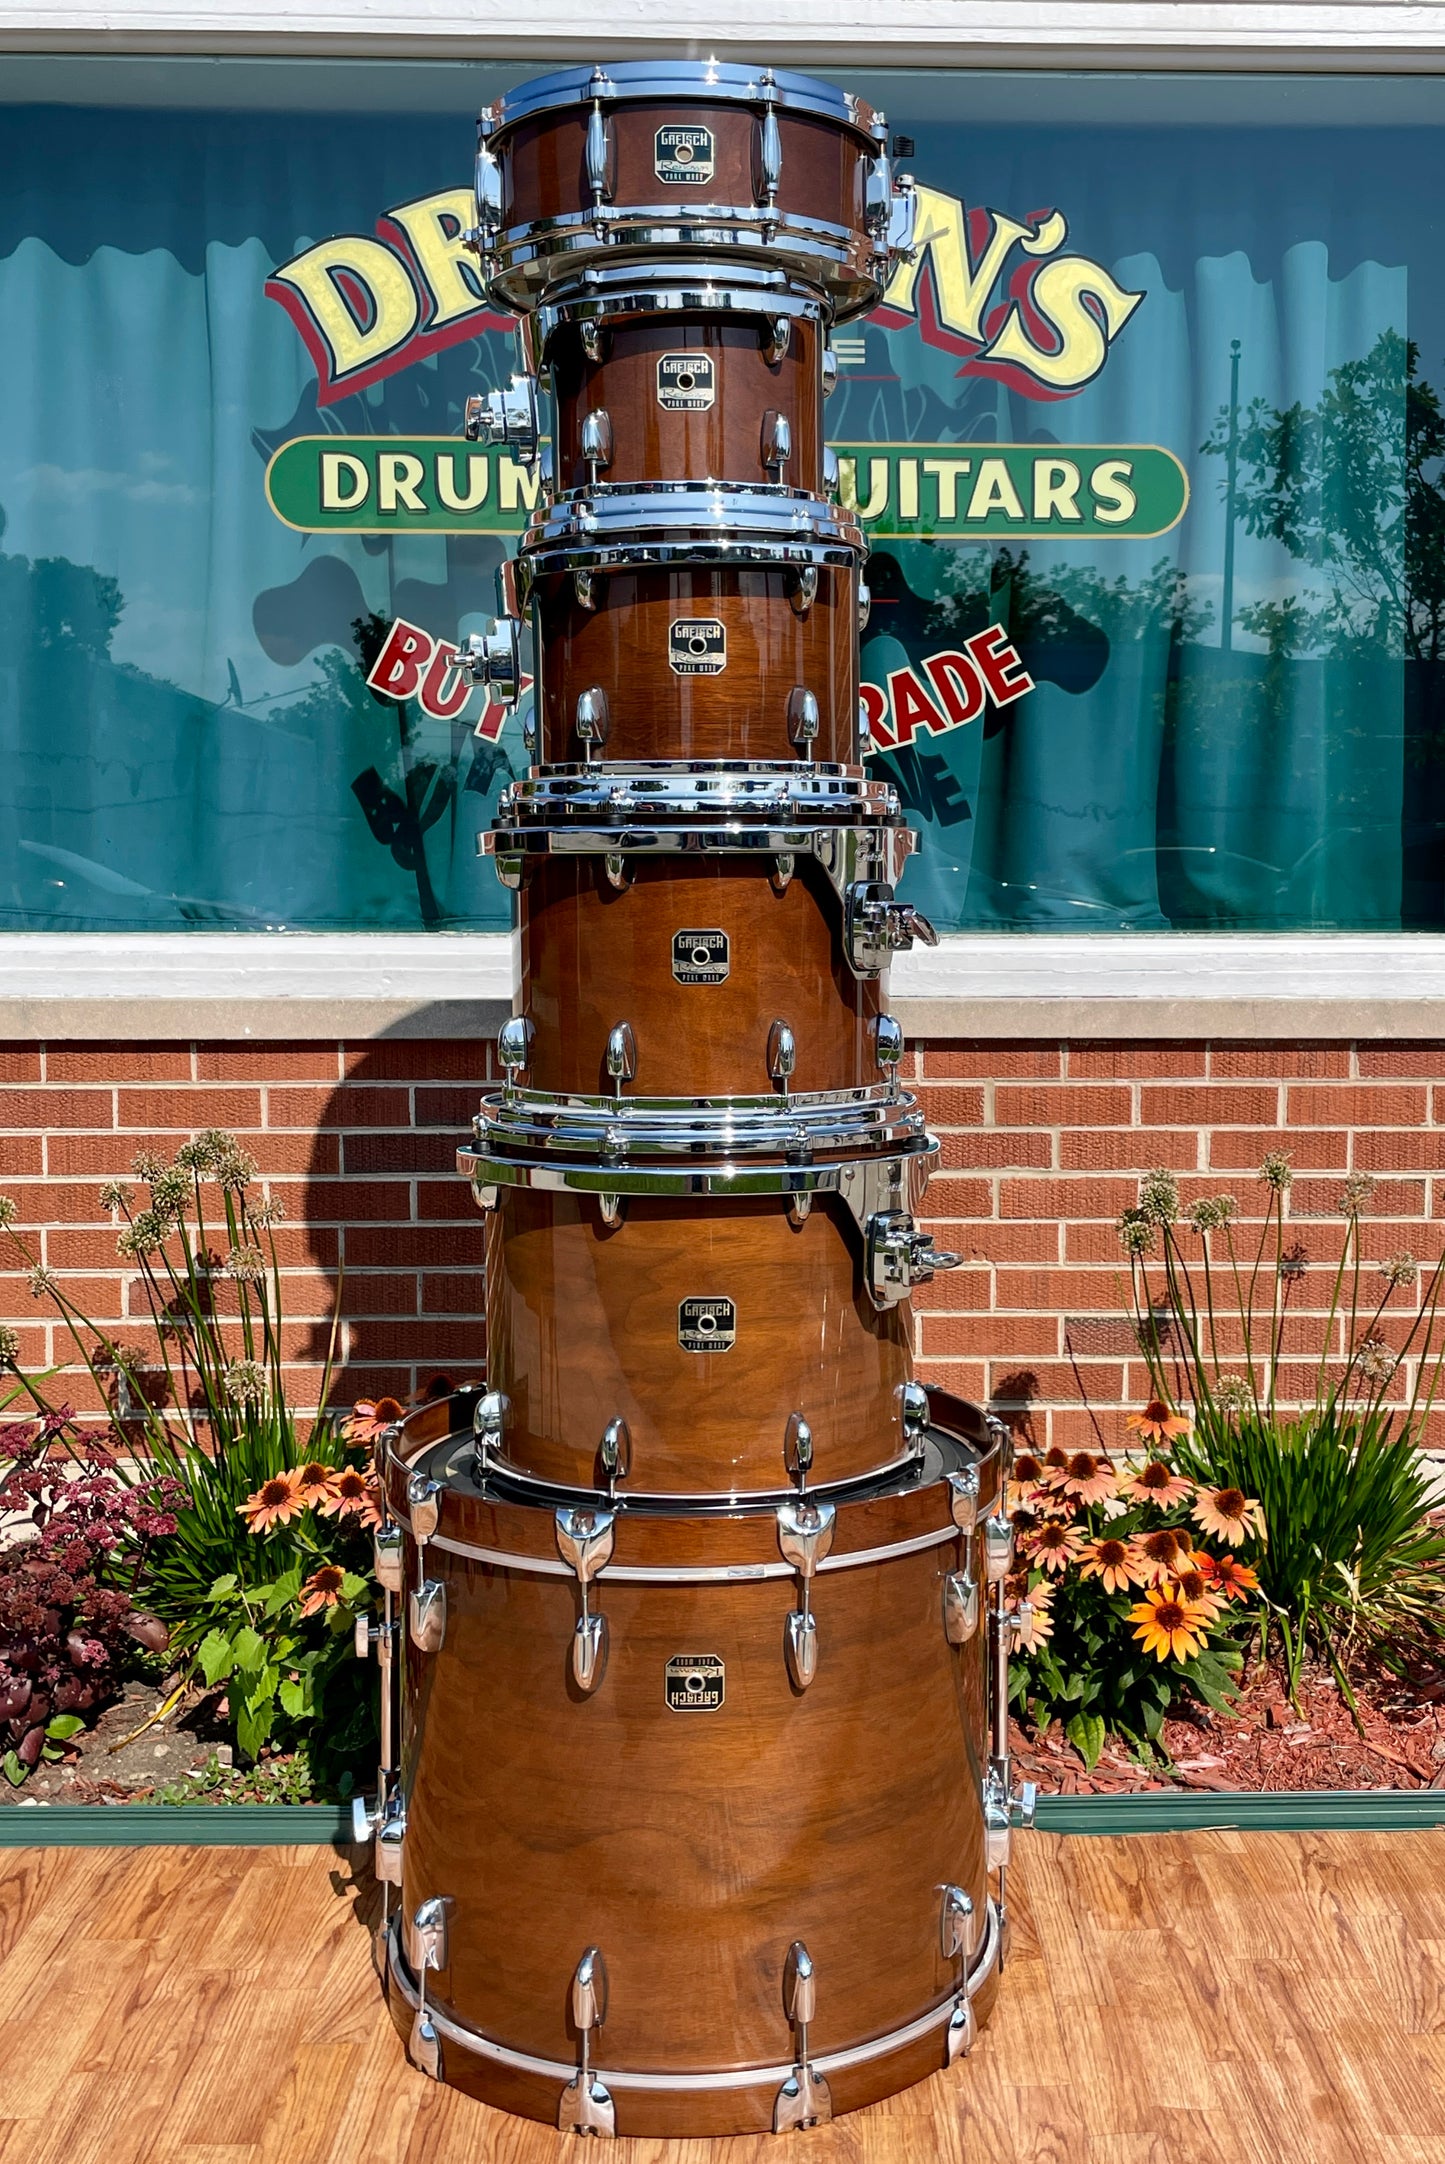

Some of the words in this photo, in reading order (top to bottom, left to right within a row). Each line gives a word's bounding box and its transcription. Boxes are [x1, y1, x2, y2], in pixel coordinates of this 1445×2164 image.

[661, 132, 708, 146] GRETSCH
[663, 360, 709, 374] GRETSCH
[321, 453, 541, 514] DRUM
[838, 458, 1138, 524] UITARS
[675, 625, 721, 639] GRETSCH
[859, 622, 1036, 757] RADE
[678, 935, 724, 949] GRETSCH
[684, 1303, 731, 1317] GRETSCH
[671, 1691, 719, 1706] GRETSCH
